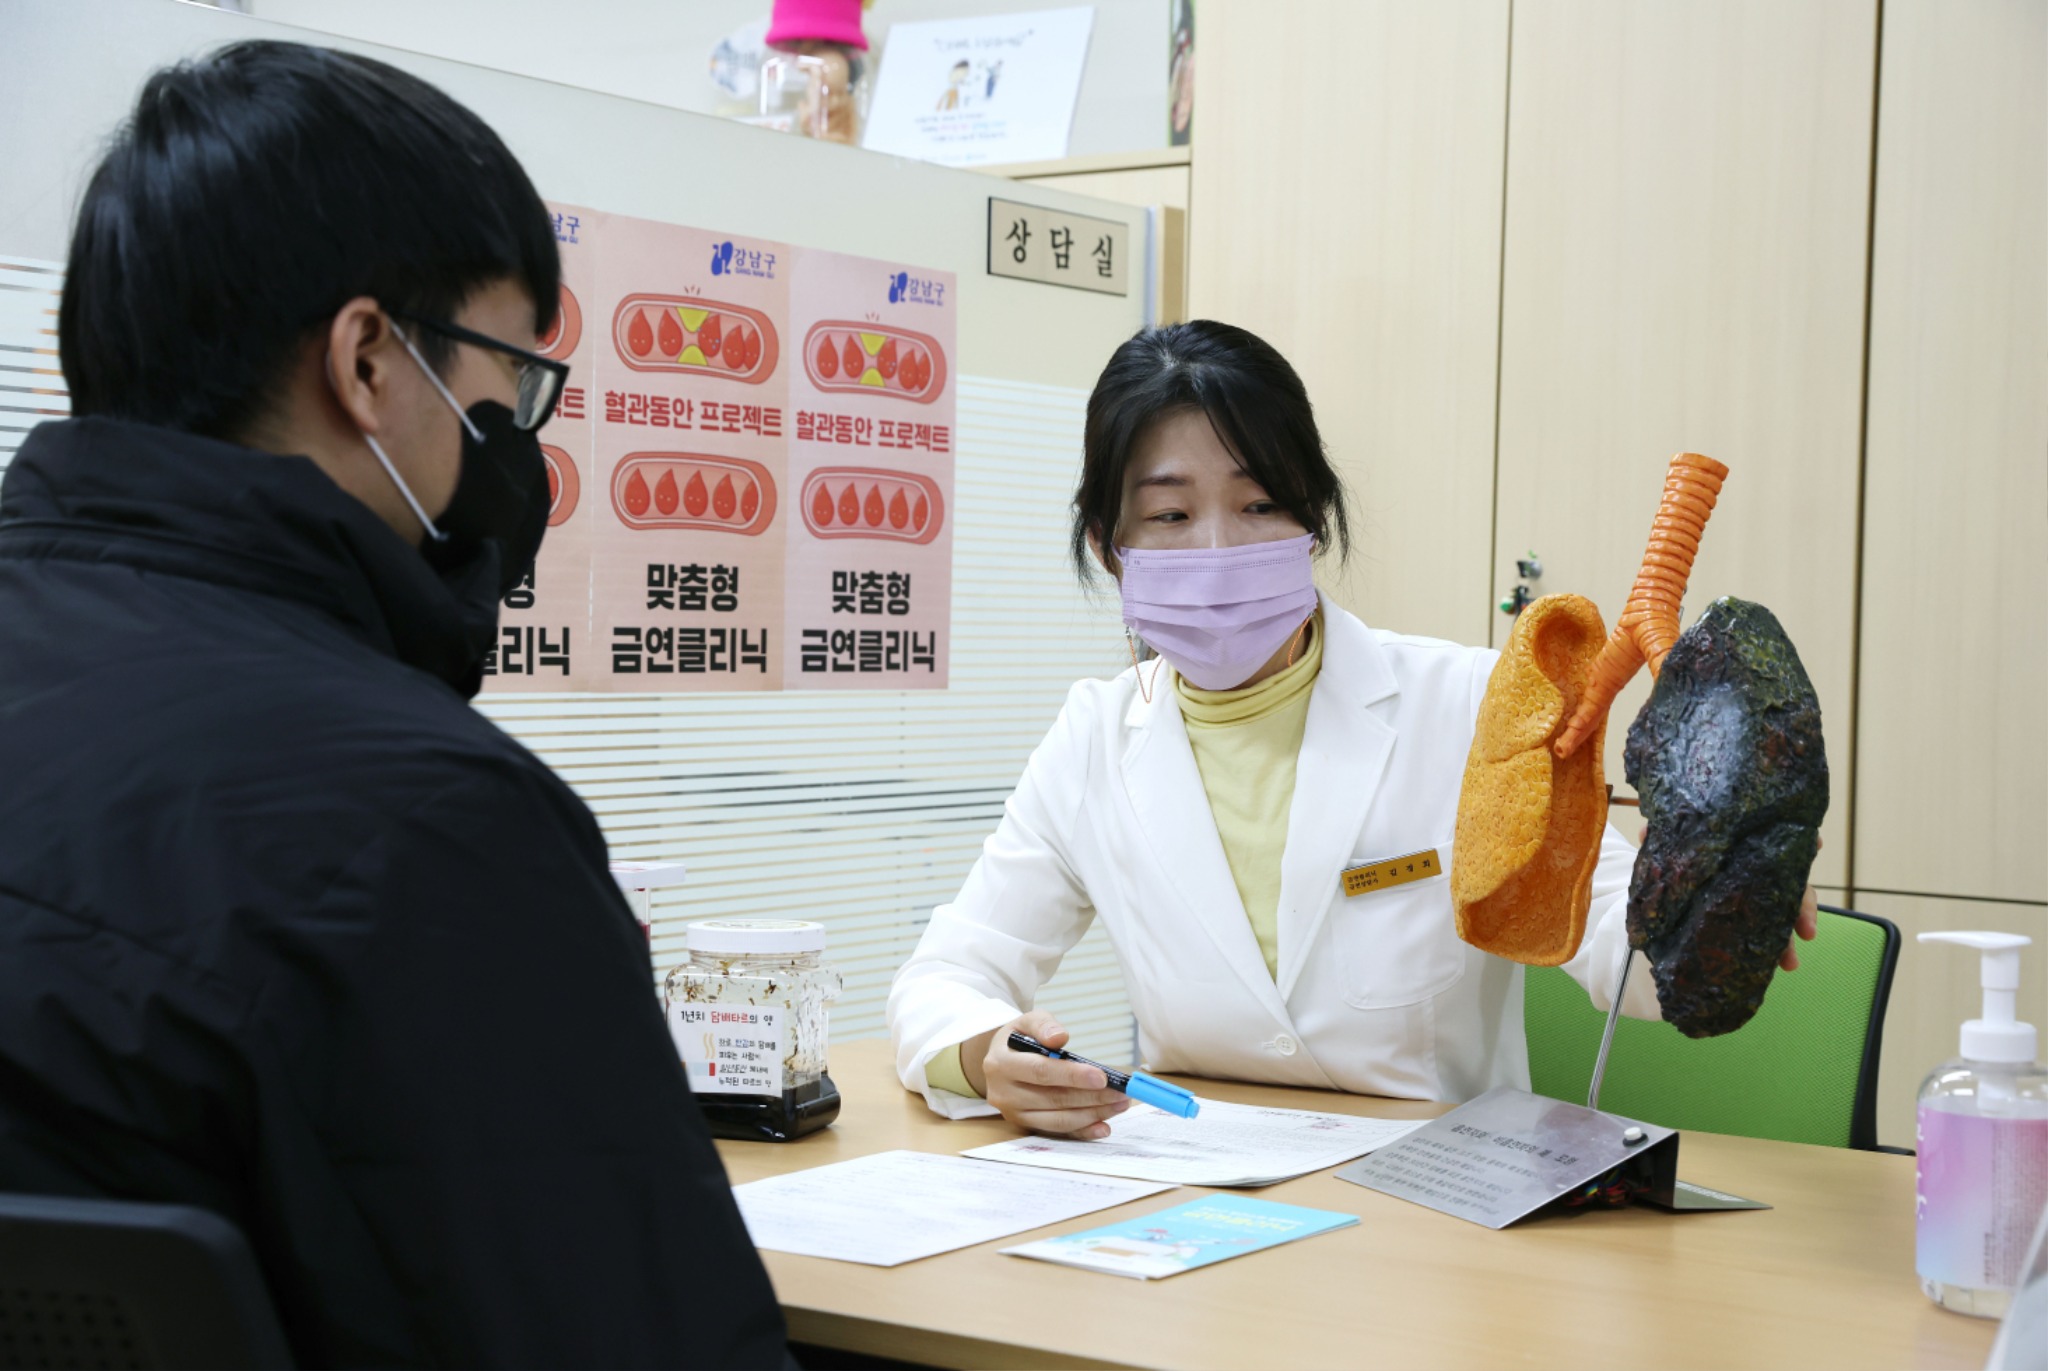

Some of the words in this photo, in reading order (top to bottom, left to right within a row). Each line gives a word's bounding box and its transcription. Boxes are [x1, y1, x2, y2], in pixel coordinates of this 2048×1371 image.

[549, 212, 580, 235] 남구
[734, 248, 776, 271] 강남구
[909, 278, 945, 299] 강남구
[605, 389, 694, 430] 혈관동안
[699, 401, 782, 437] 프로젝트
[797, 410, 873, 446] 혈관동안
[878, 419, 950, 453] 프로젝트
[646, 563, 739, 612] 맞춤형
[832, 570, 911, 616] 맞춤형
[611, 626, 767, 674] 금연클리닉
[801, 629, 936, 673] 금연클리닉
[681, 1010, 705, 1023] 1년치
[711, 1010, 758, 1024] 담배타르의
[763, 1014, 774, 1026] 양
